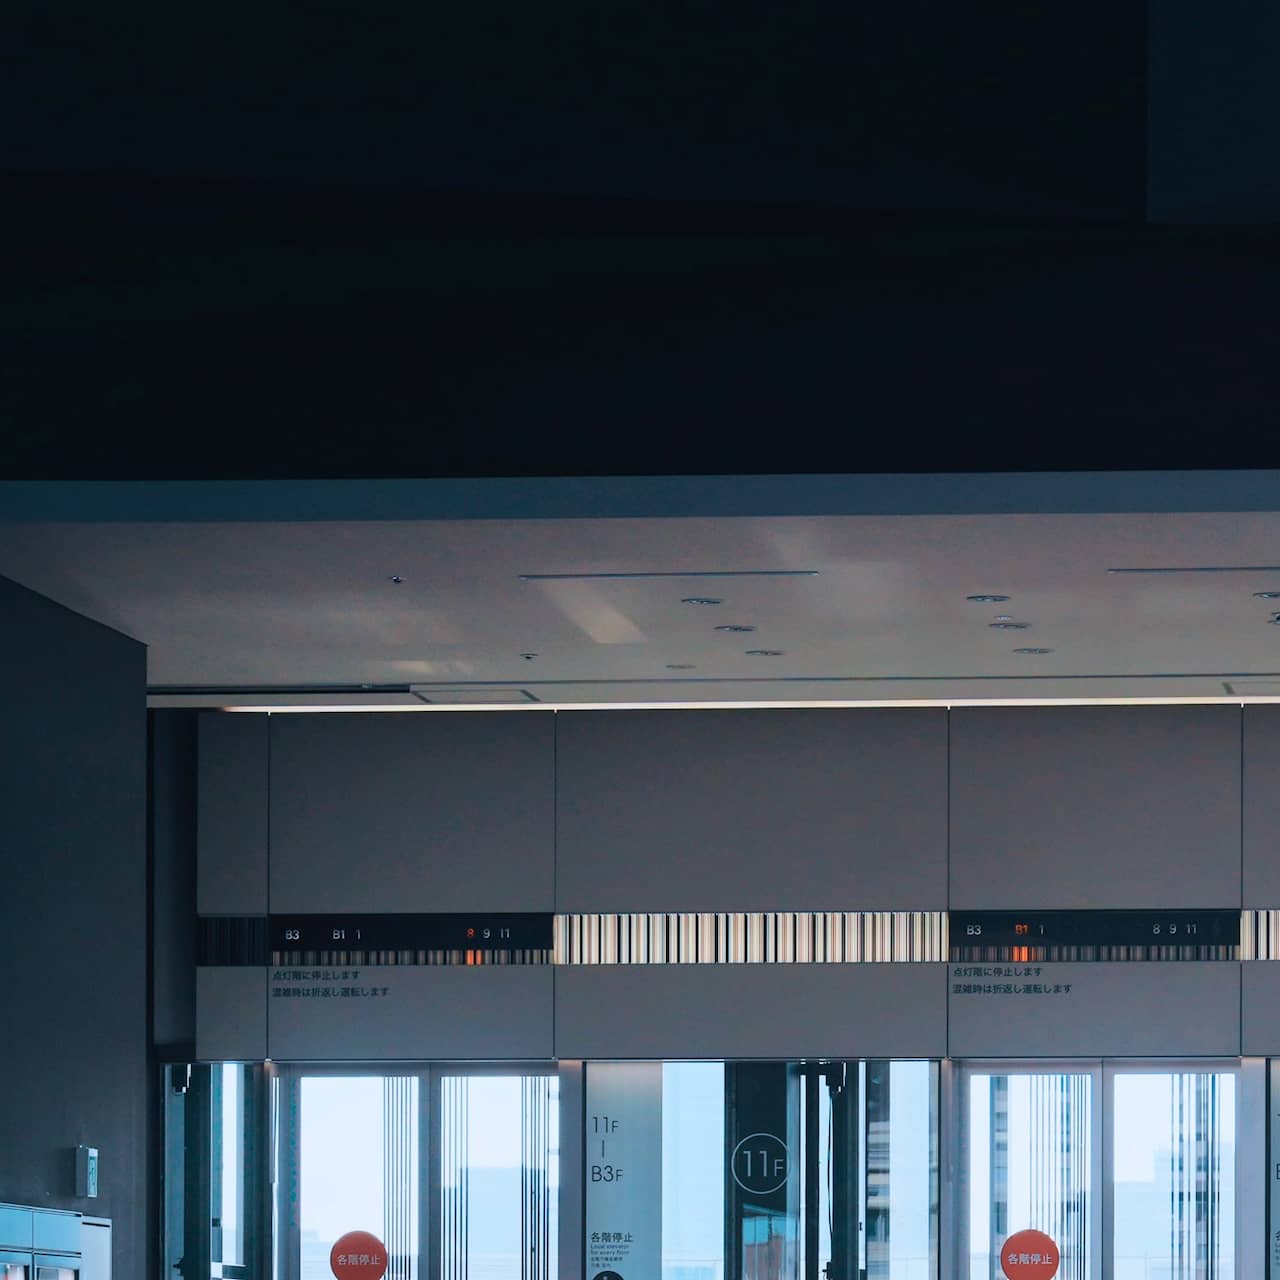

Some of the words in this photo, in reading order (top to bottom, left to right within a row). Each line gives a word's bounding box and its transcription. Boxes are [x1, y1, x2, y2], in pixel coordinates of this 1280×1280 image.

[285, 929, 300, 940] B3
[332, 929, 346, 940] B1
[482, 929, 491, 939] 9
[500, 928, 510, 939] 11
[966, 925, 982, 935] B3
[1015, 924, 1029, 935] B1
[1153, 924, 1161, 935] 8
[1169, 924, 1177, 935] 9
[1186, 924, 1198, 934] 11
[592, 1116, 620, 1133] 11F
[743, 1150, 785, 1177] 11F
[591, 1165, 624, 1182] B3F
[591, 1232, 634, 1243] 各階停止
[337, 1254, 381, 1266] 各階停止
[1007, 1253, 1053, 1265] 各階停止
